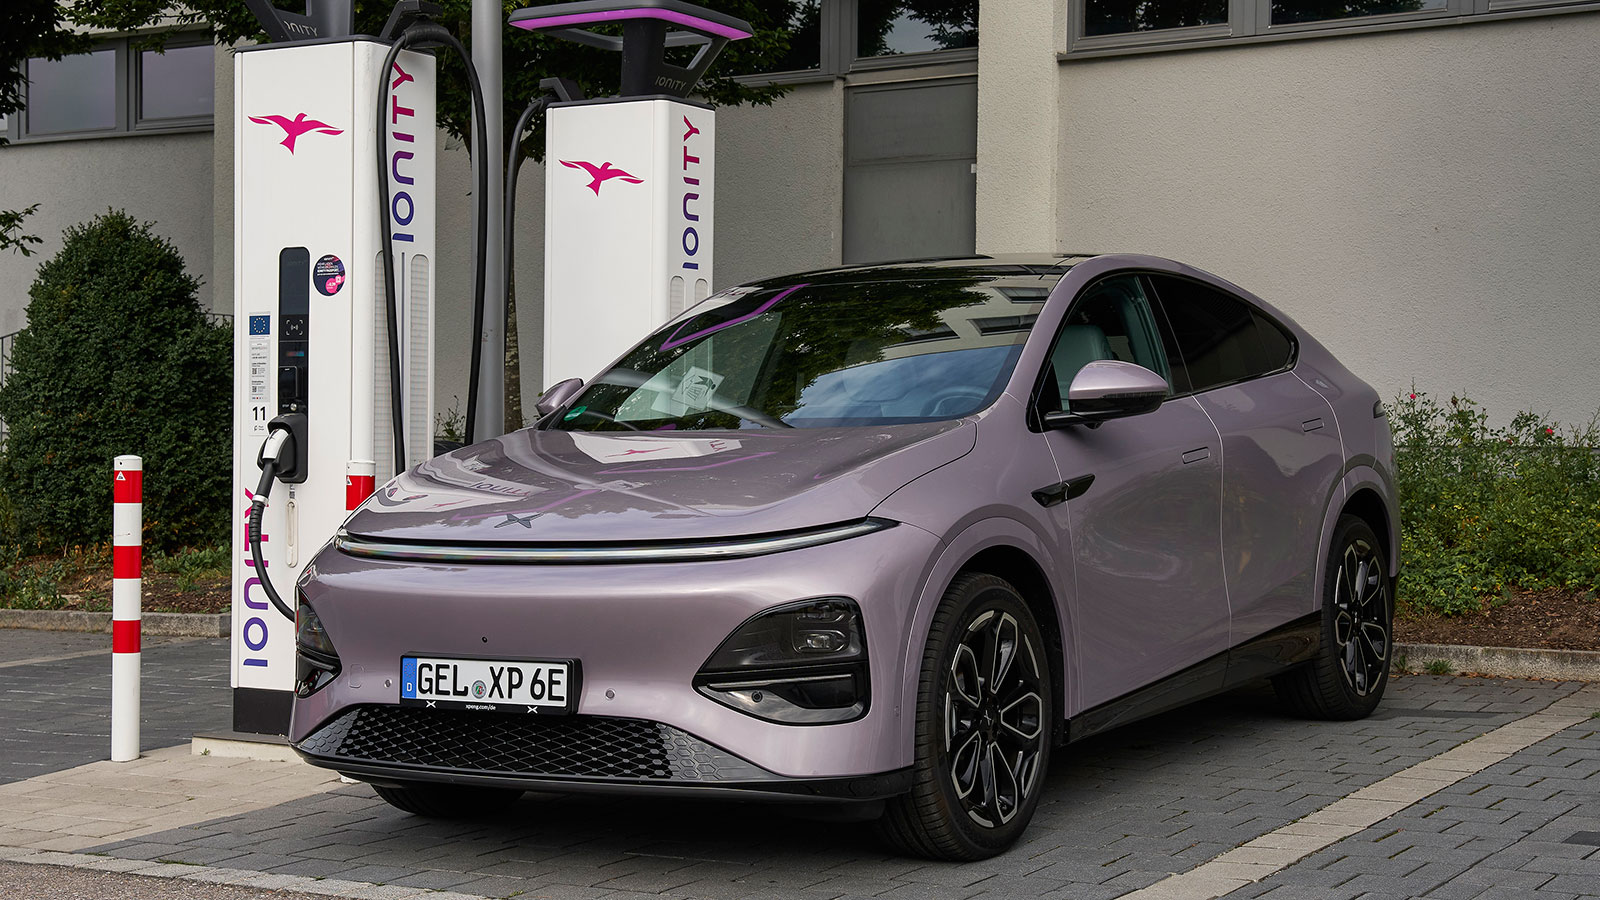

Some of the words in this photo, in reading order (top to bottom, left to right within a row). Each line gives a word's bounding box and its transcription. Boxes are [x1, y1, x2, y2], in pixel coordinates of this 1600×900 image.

[655, 75, 687, 91] IONITY
[392, 61, 415, 243] IONITY
[682, 114, 700, 271] IONITY
[252, 405, 266, 421] 11
[406, 682, 413, 692] D
[417, 662, 469, 696] GEL
[488, 665, 524, 699] XP
[529, 667, 565, 702] 6E
